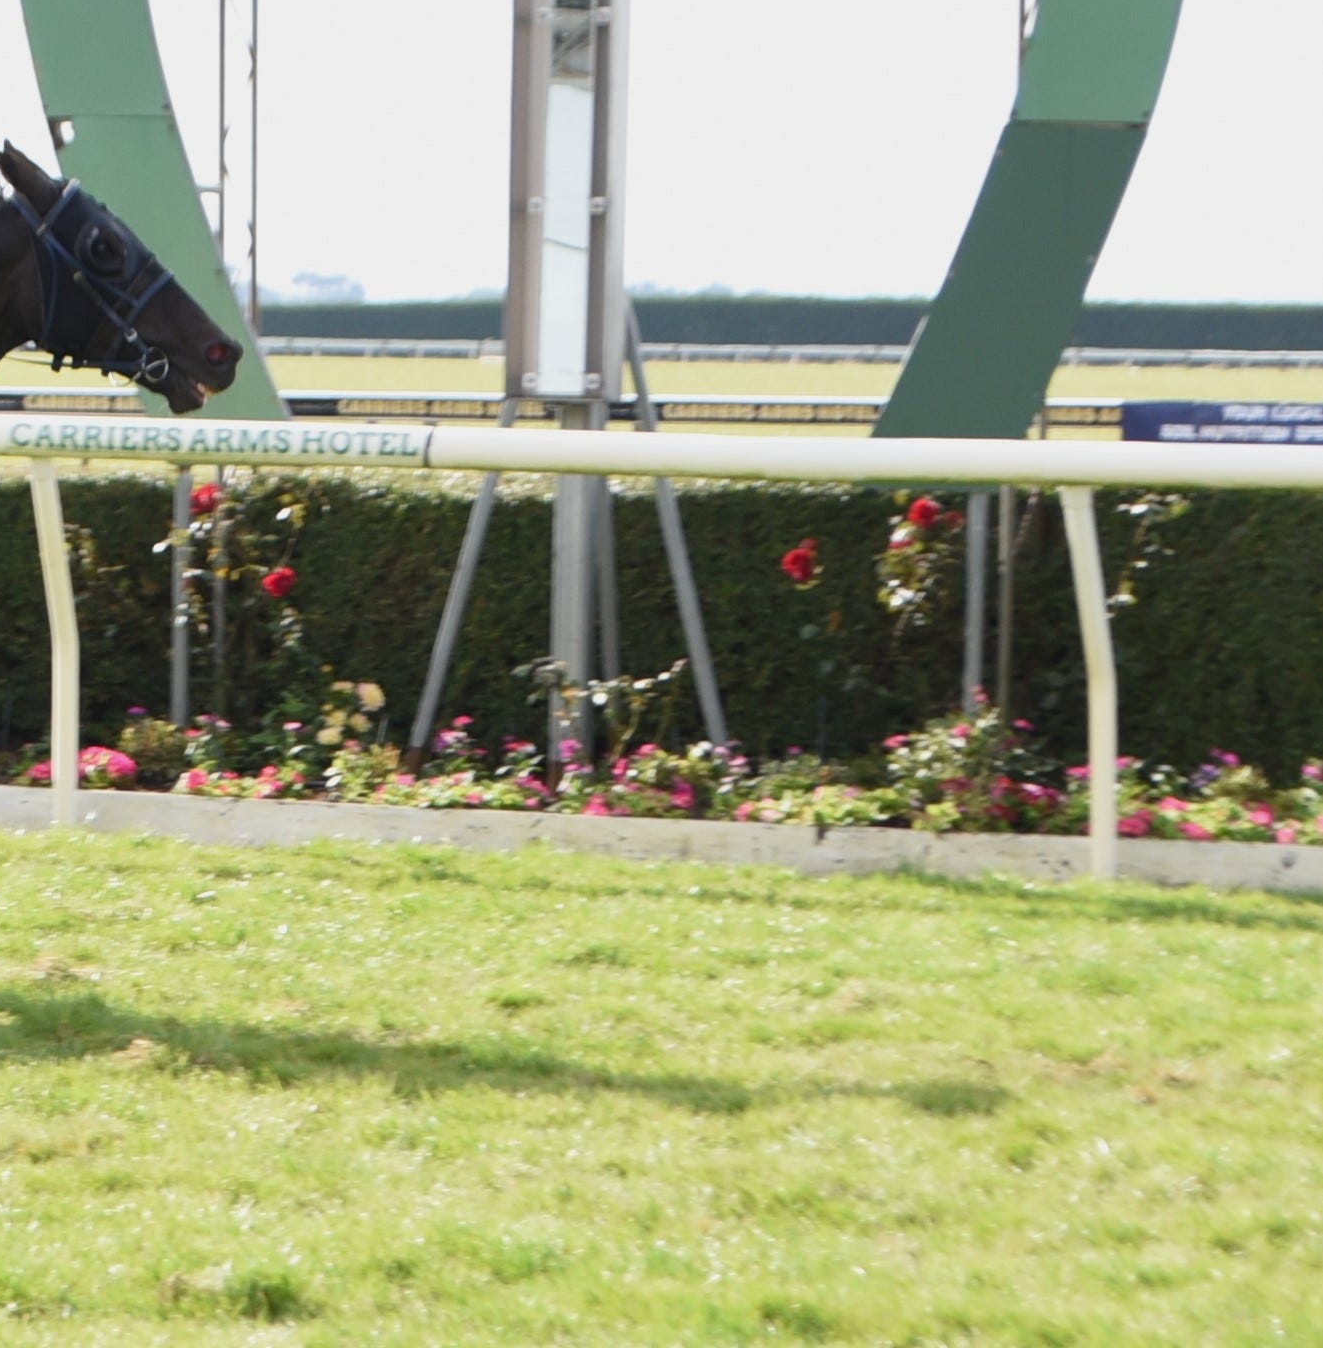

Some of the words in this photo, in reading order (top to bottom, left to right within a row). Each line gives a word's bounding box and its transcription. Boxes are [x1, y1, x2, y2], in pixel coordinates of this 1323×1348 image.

[10, 423, 183, 452] CARRIERS
[188, 427, 292, 454] ARMS
[301, 429, 419, 457] HOTEL
